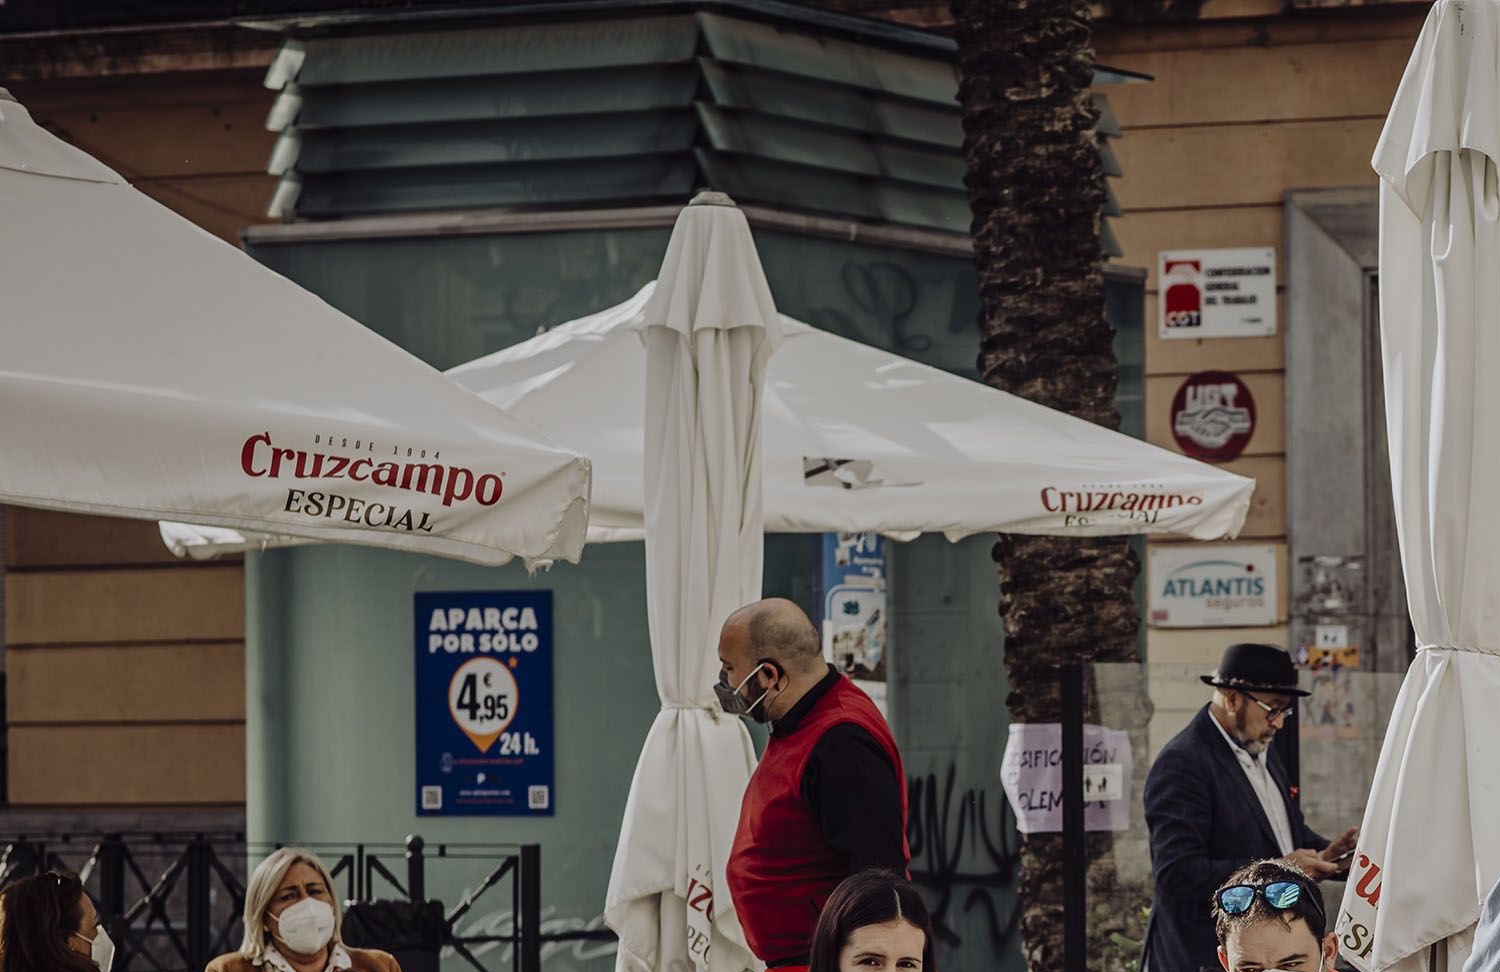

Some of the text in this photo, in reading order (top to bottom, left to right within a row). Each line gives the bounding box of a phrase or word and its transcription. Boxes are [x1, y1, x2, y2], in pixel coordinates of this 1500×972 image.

[1166, 310, 1201, 327] CGT
[1185, 383, 1238, 411] UGT
[313, 433, 441, 460] DESDE 1904
[240, 431, 504, 507] Cruzcampo
[283, 488, 434, 533] ESPECIAL
[1162, 576, 1264, 598] ATLANTIS
[428, 606, 539, 632] APARCA
[428, 632, 475, 654] POR
[499, 731, 521, 756] 24
